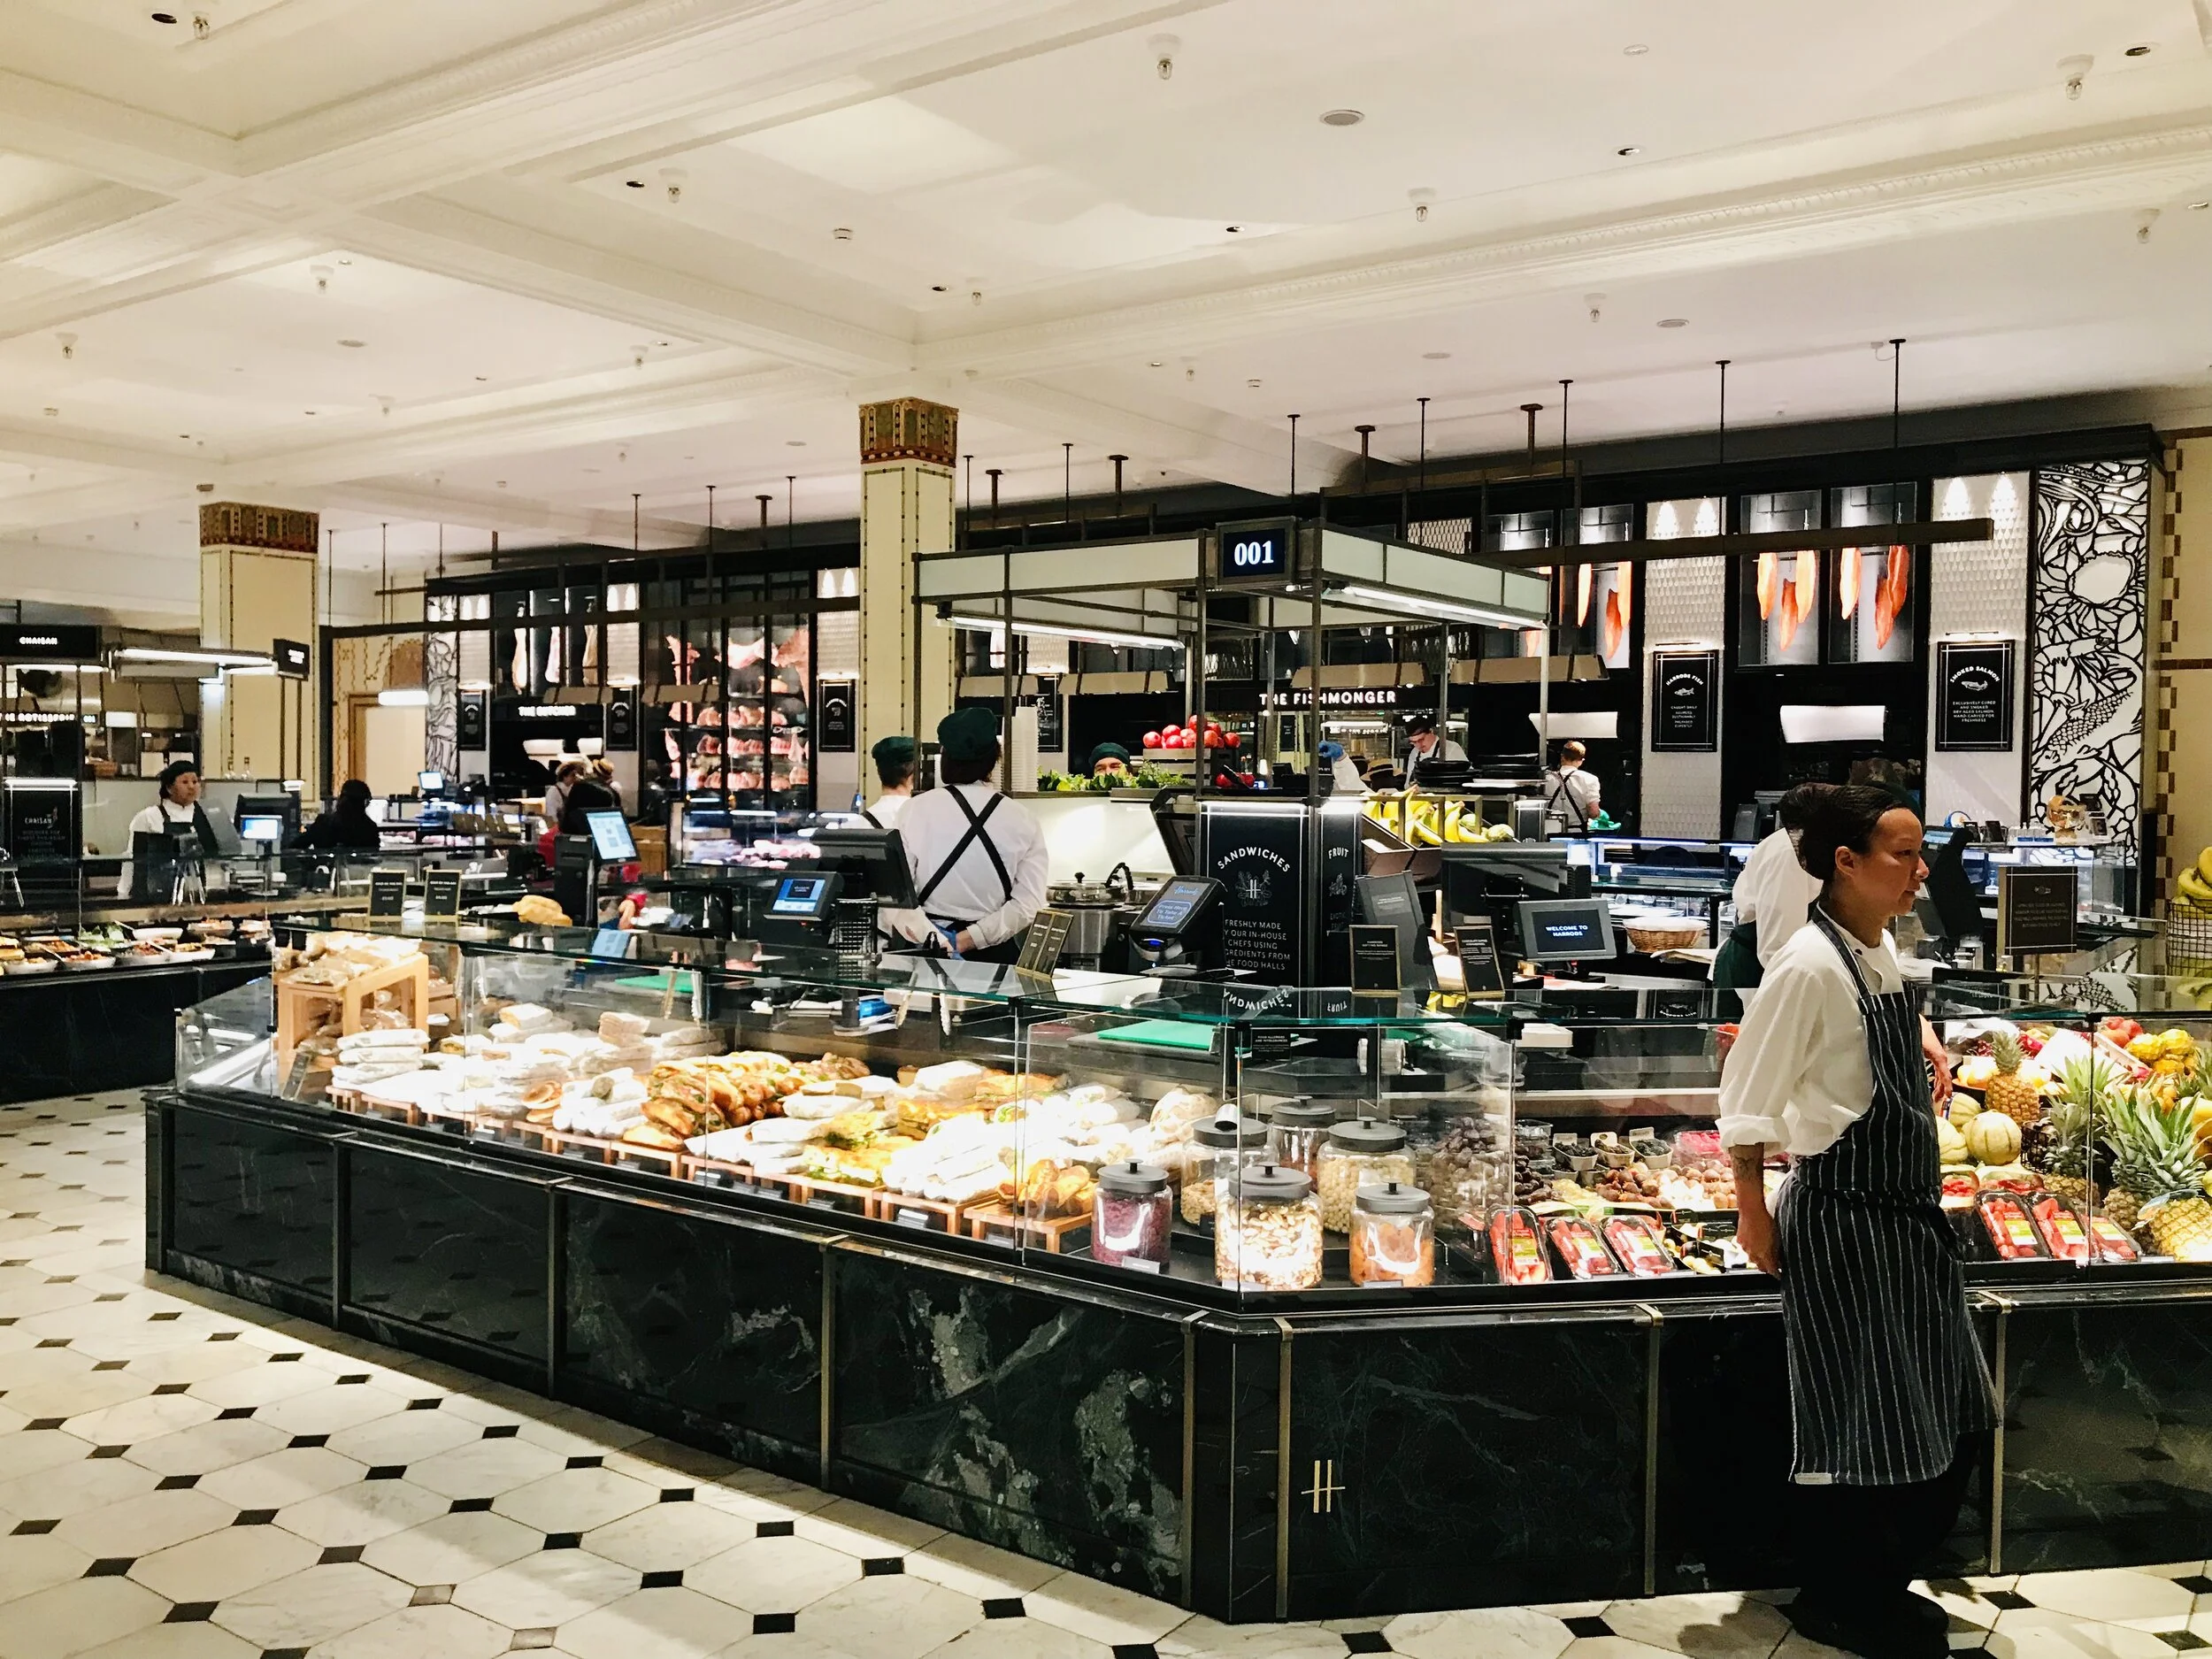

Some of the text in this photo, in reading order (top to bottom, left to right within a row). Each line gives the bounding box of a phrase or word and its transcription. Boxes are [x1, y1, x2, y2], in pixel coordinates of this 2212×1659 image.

[1234, 541, 1274, 566] 001
[1666, 673, 1703, 686] HARRODS FISH
[1950, 665, 2000, 682] SMOKED SALMON
[1259, 690, 1396, 705] THE FISHMONGER
[1328, 847, 1348, 859] FRUIT
[1217, 847, 1290, 872] SANDWICHES
[1259, 921, 1281, 930] MADE
[1249, 931, 1286, 941] IN-HOUSE
[1228, 939, 1251, 948] CHEFS
[1225, 949, 1266, 958] GREDIENTS
[1238, 959, 1258, 968] FOOD
